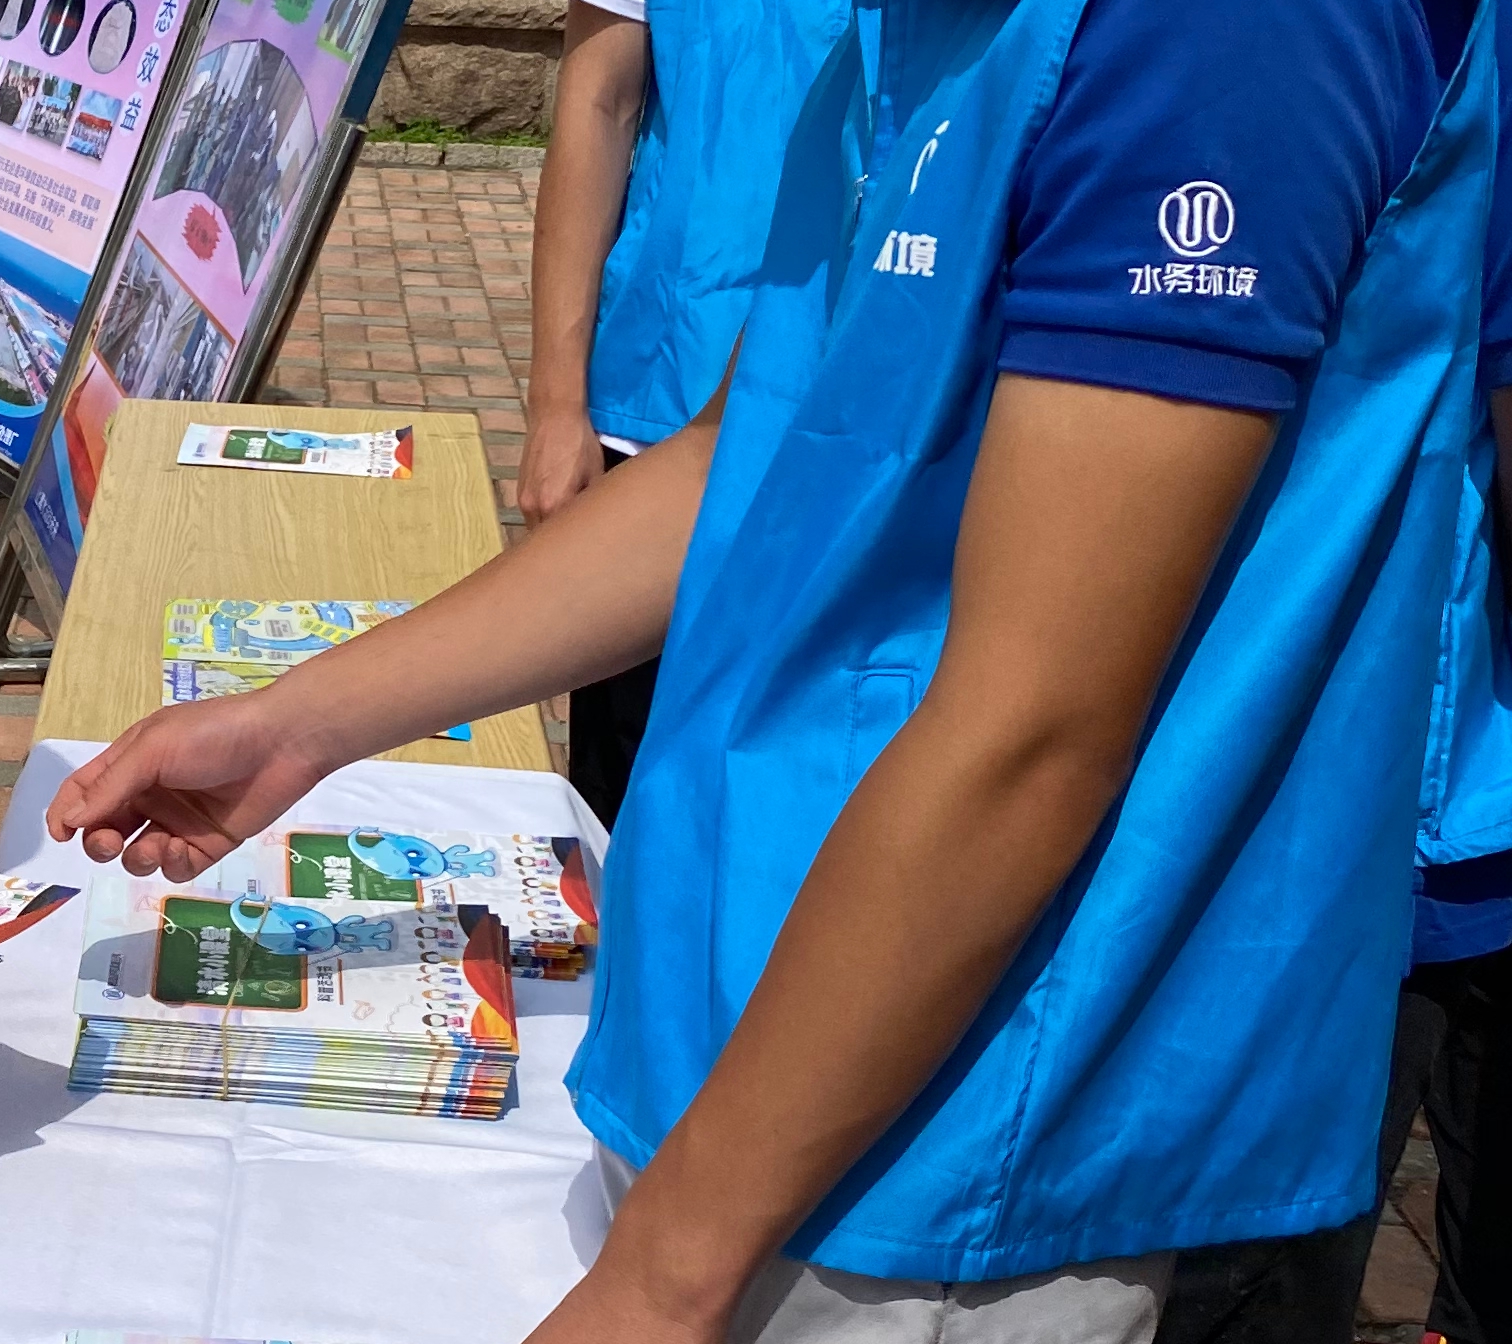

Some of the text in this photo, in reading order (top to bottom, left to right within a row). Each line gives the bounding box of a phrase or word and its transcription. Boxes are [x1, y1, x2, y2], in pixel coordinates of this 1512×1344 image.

[1128, 263, 1259, 298] 水务环境
[197, 926, 231, 996] 清水小课堂
